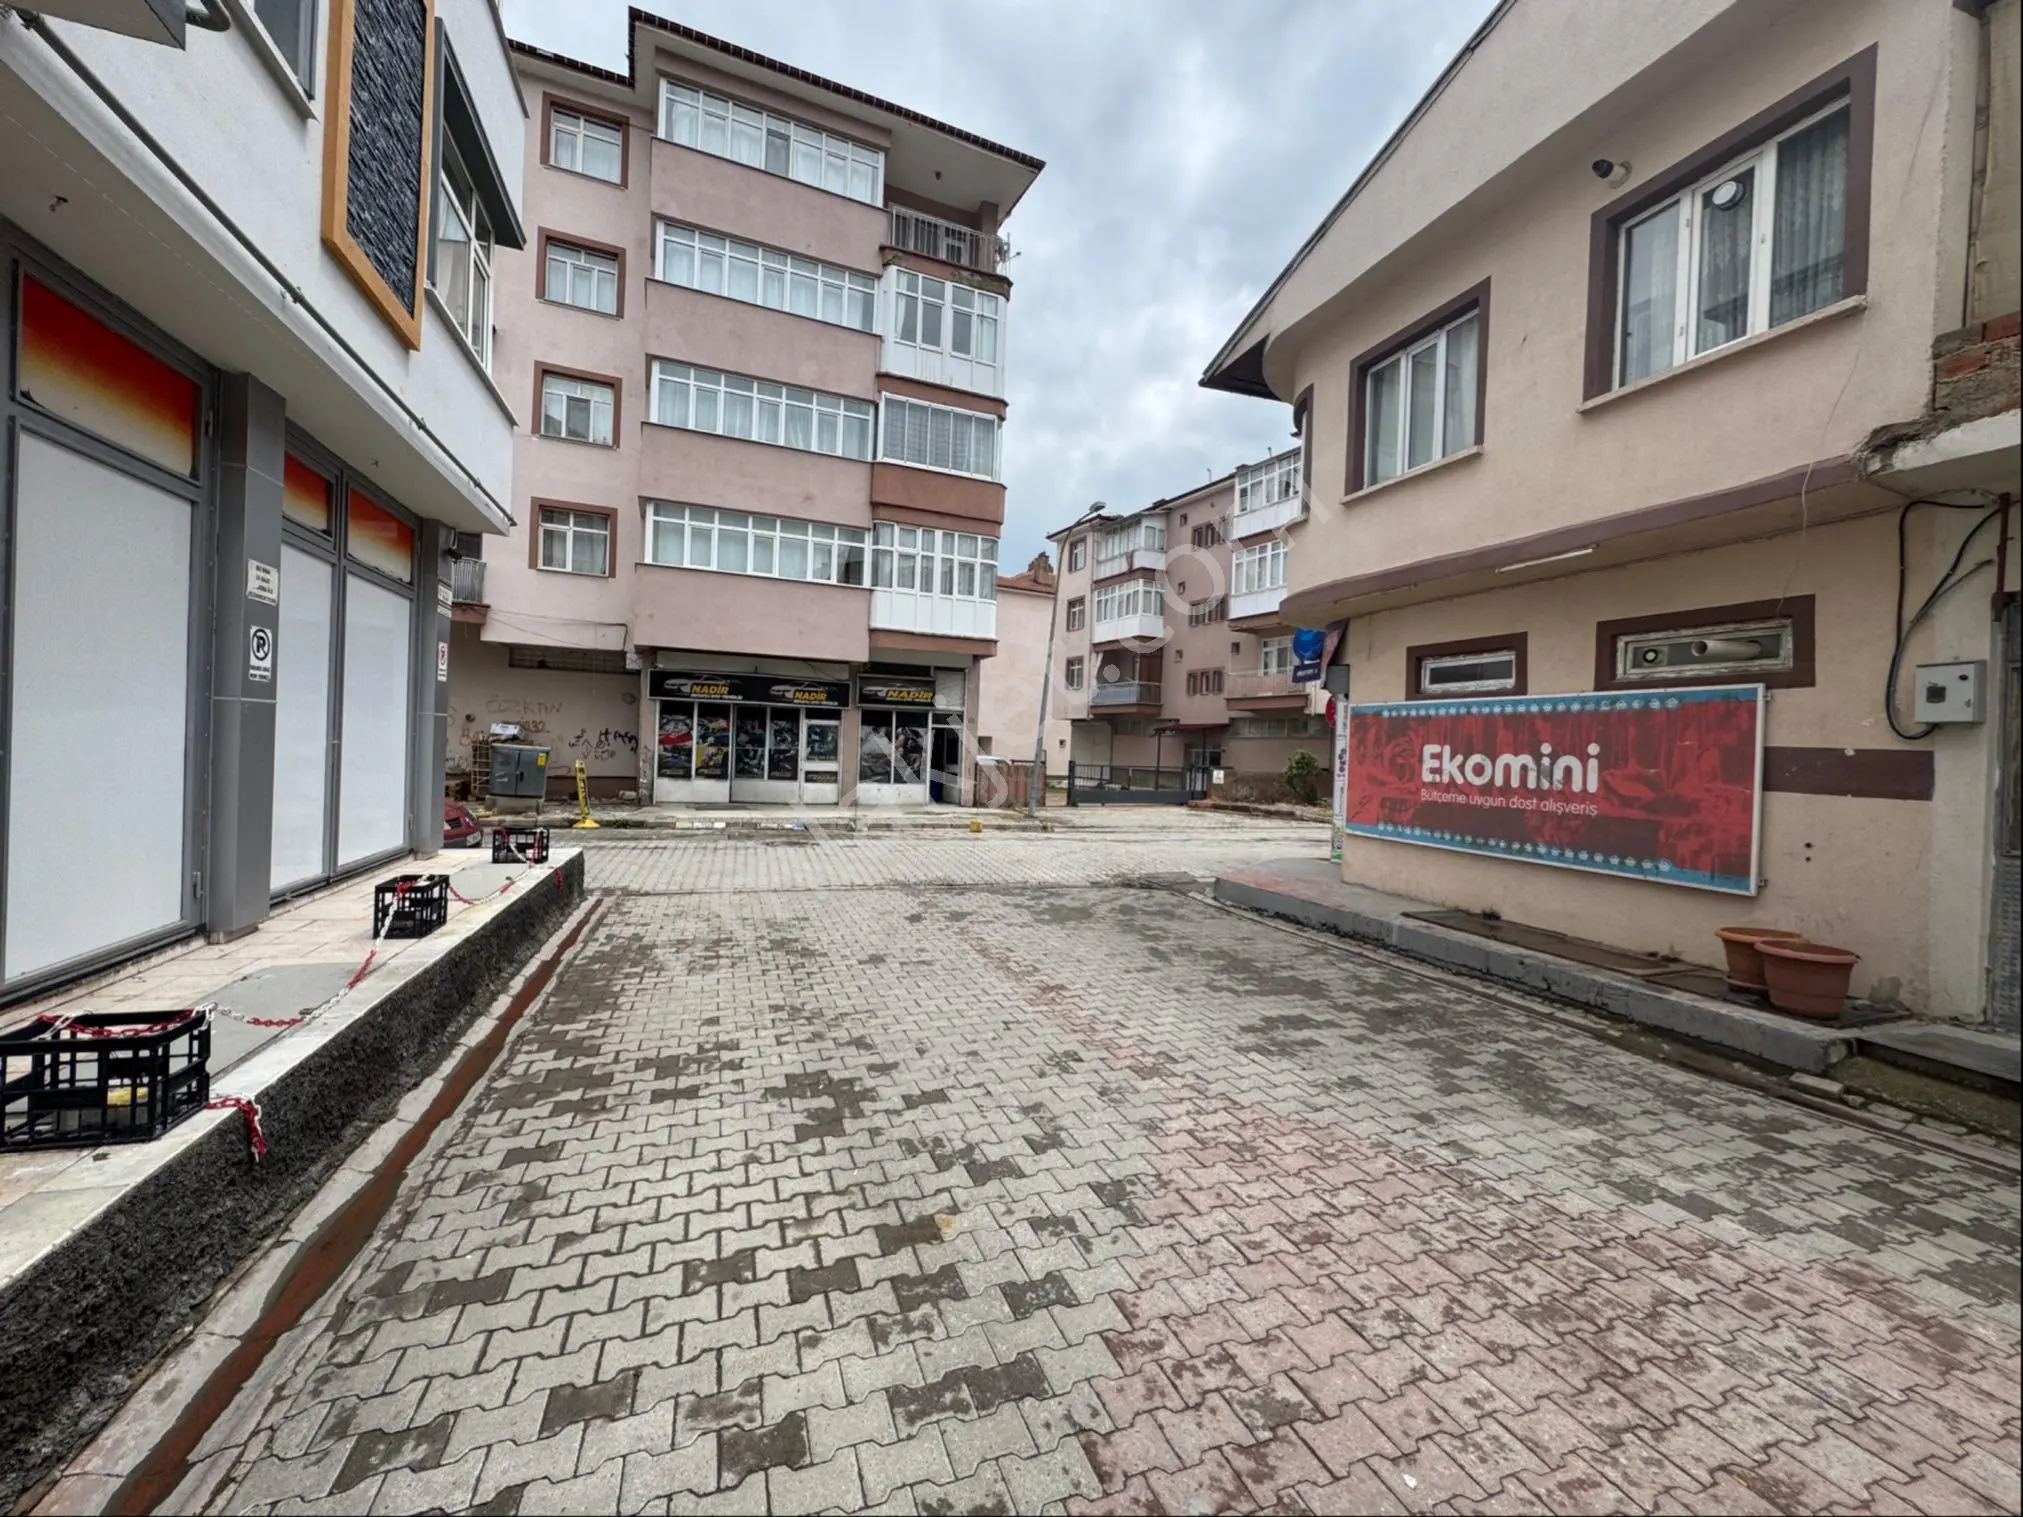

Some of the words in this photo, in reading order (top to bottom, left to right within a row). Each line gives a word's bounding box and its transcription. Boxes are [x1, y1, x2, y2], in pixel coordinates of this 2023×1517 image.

[691, 684, 729, 695] NADİR
[795, 690, 828, 701] NADİR
[1421, 742, 1600, 793] Ekomini
[1420, 788, 1466, 804] Bütçeme
[1469, 794, 1506, 808] uygun
[1509, 797, 1537, 810] dost
[1540, 800, 1598, 816] alışveriş
